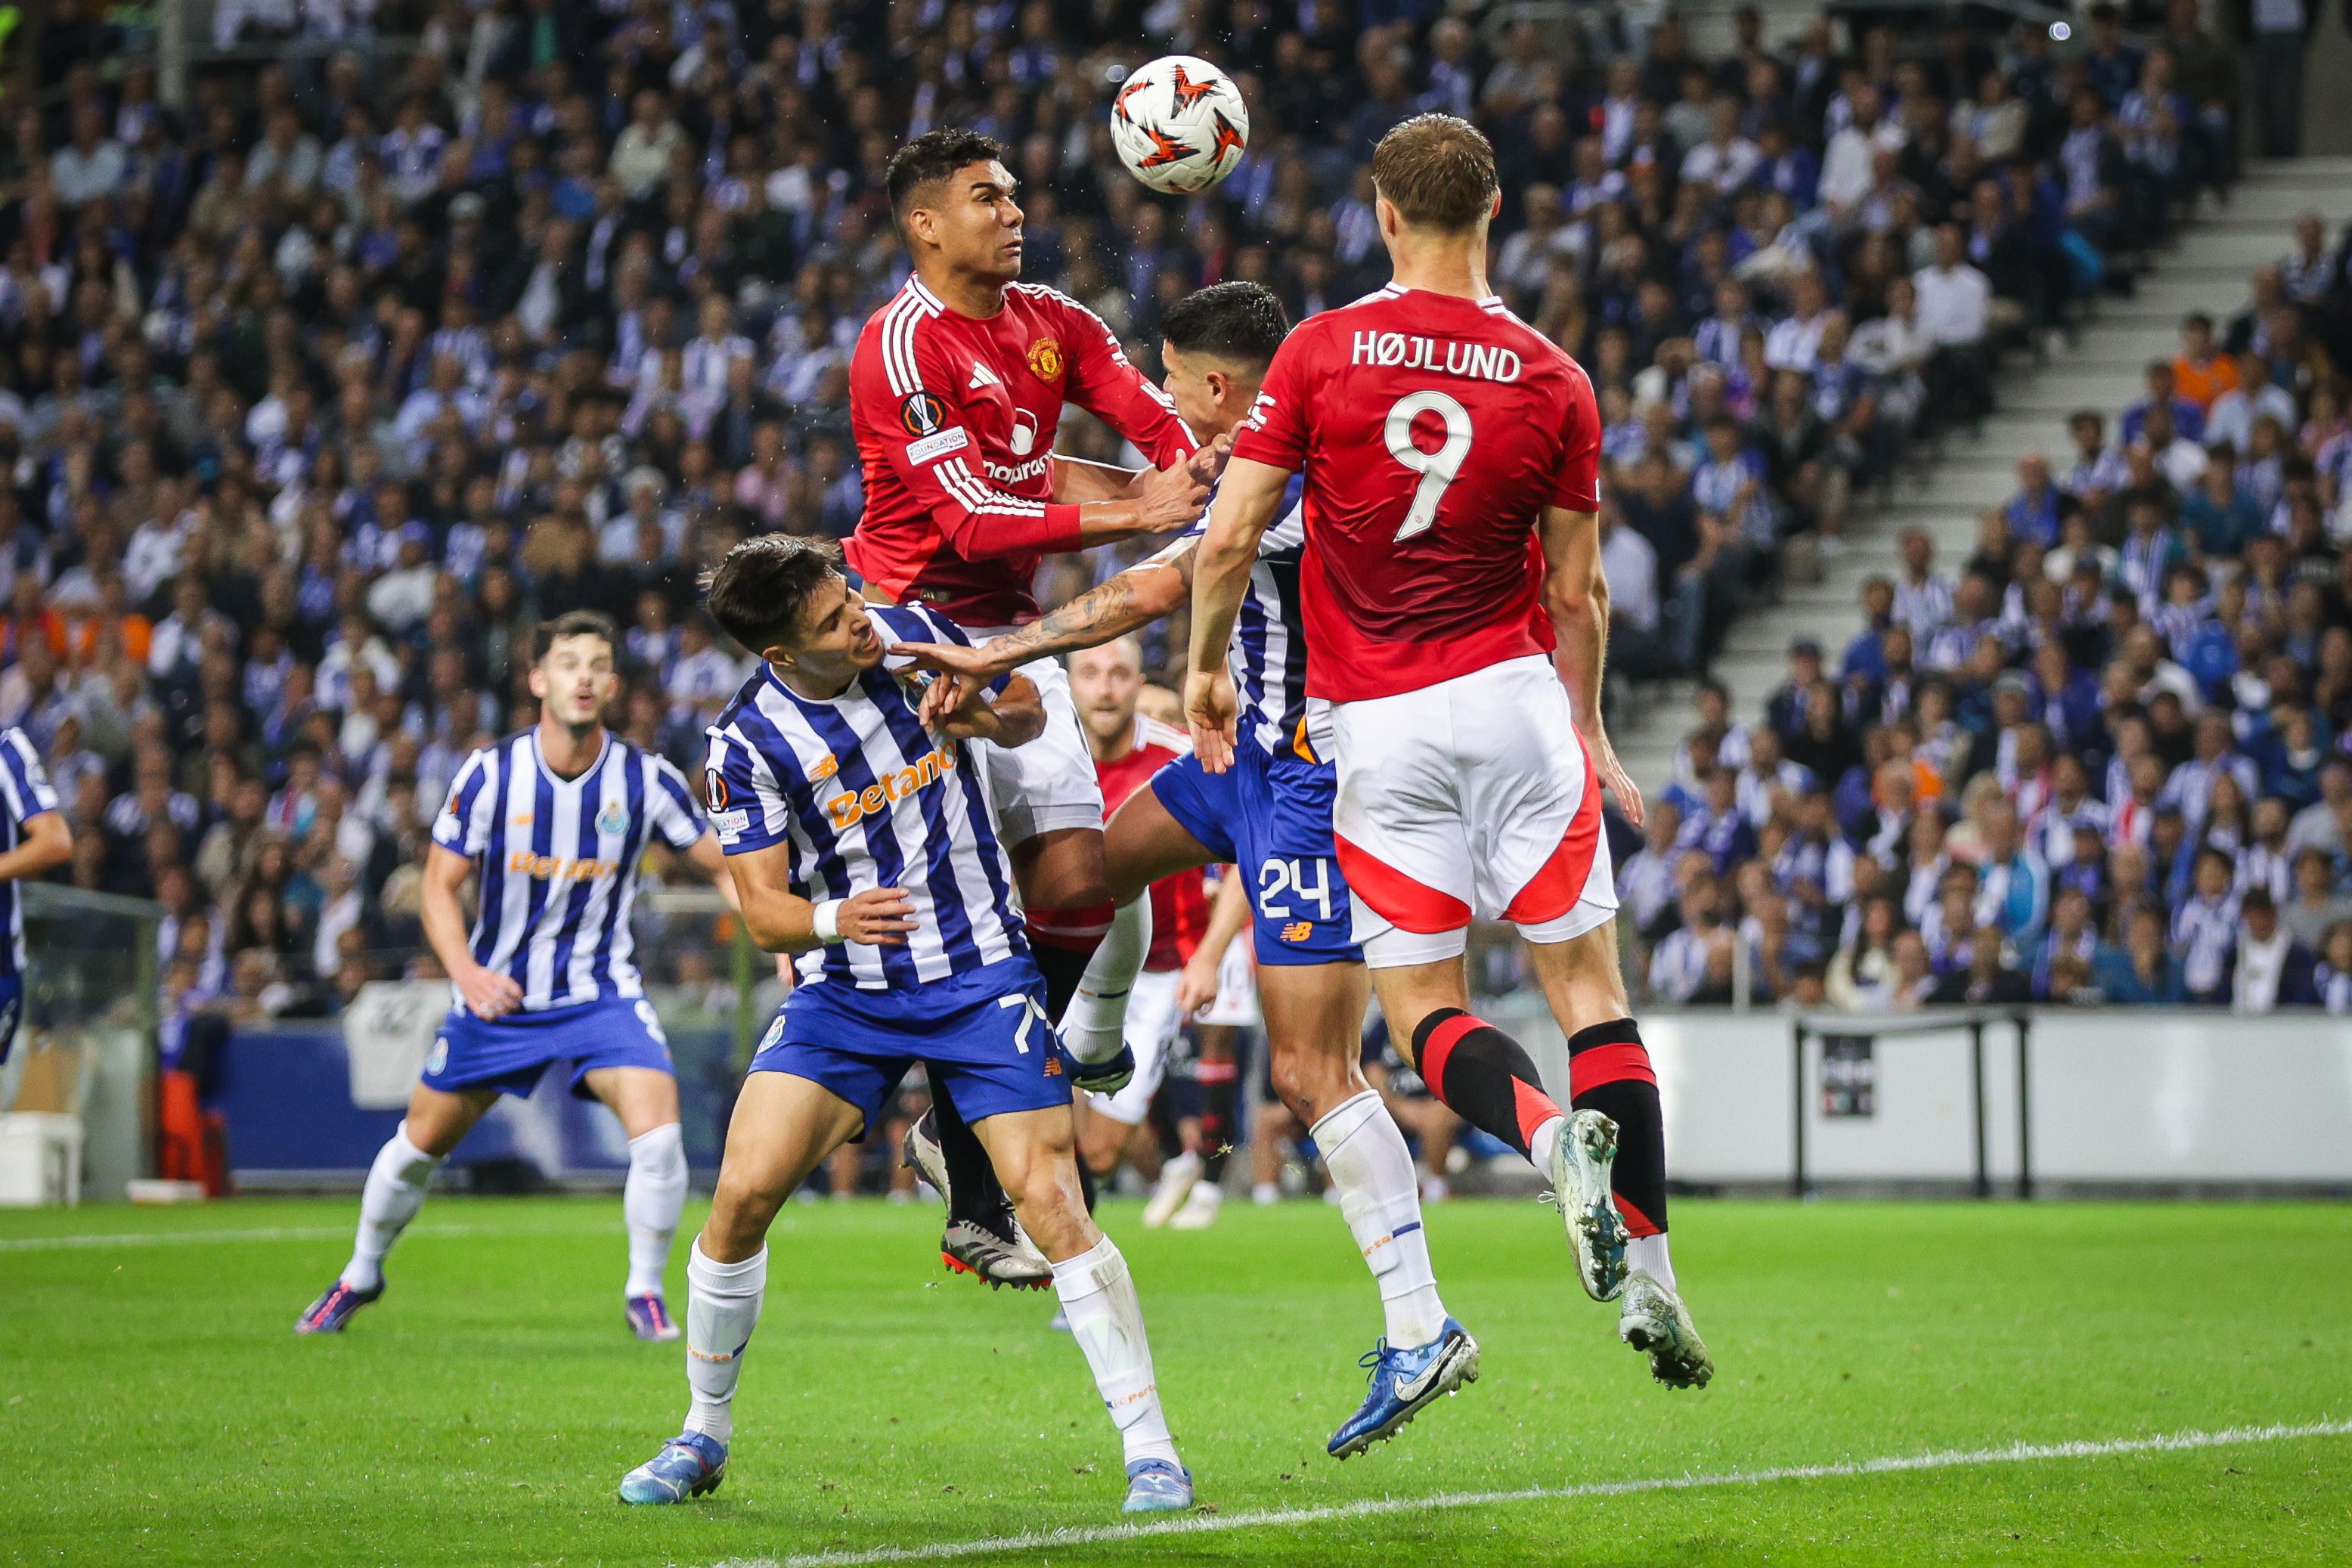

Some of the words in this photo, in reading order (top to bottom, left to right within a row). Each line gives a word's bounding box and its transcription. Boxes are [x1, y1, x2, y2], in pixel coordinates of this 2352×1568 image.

[1352, 330, 1523, 383] HØJLUND
[909, 433, 965, 458] FOUNDATION
[1384, 390, 1473, 544] 9
[826, 740, 959, 830] Betano
[1258, 857, 1331, 920] 24
